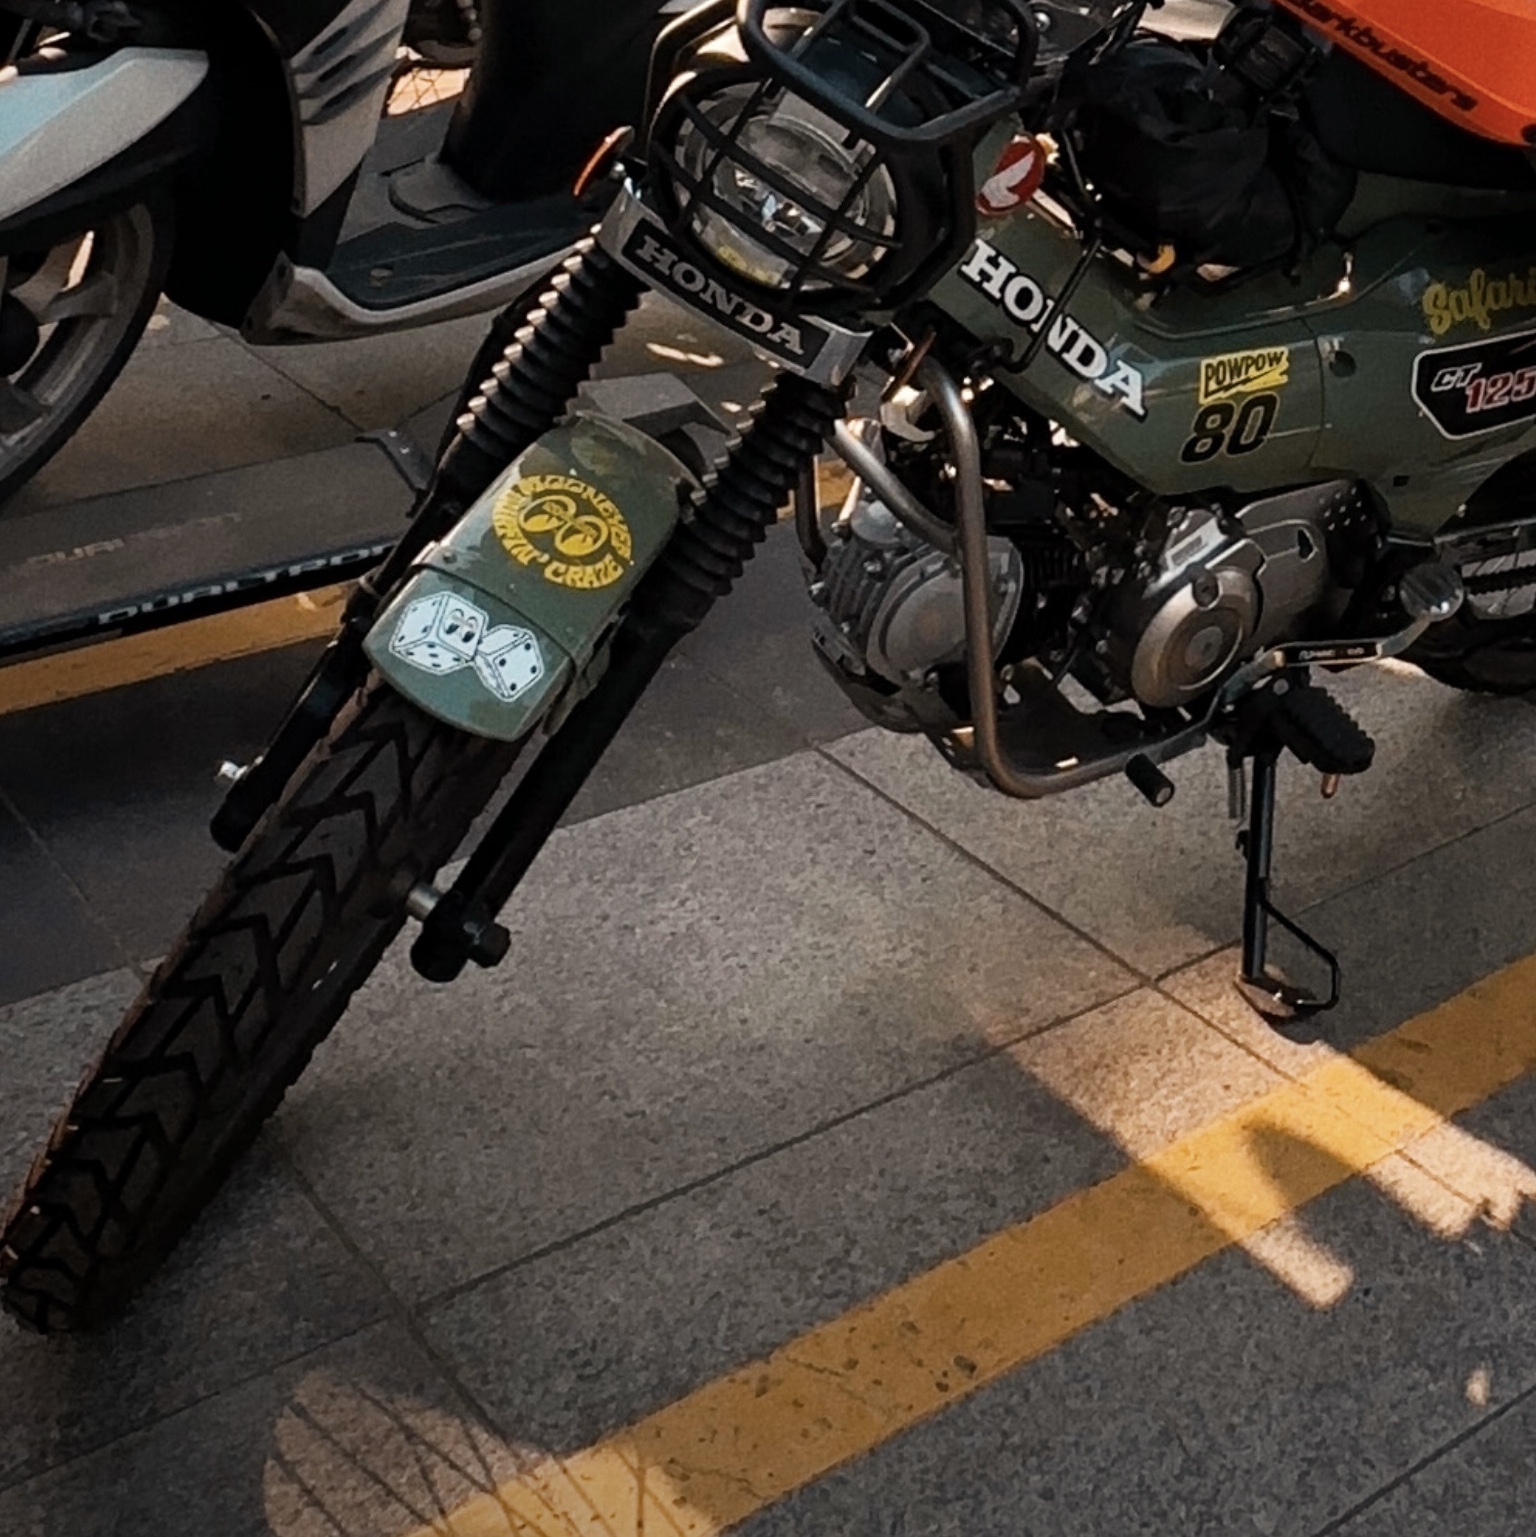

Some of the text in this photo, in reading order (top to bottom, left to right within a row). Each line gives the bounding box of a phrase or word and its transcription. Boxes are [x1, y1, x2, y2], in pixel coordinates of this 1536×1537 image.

[634, 233, 805, 358] HONDA
[960, 238, 1146, 419] HONDA
[1204, 349, 1285, 397] POWPOW
[1431, 362, 1483, 393] CT
[1180, 392, 1280, 464] 80
